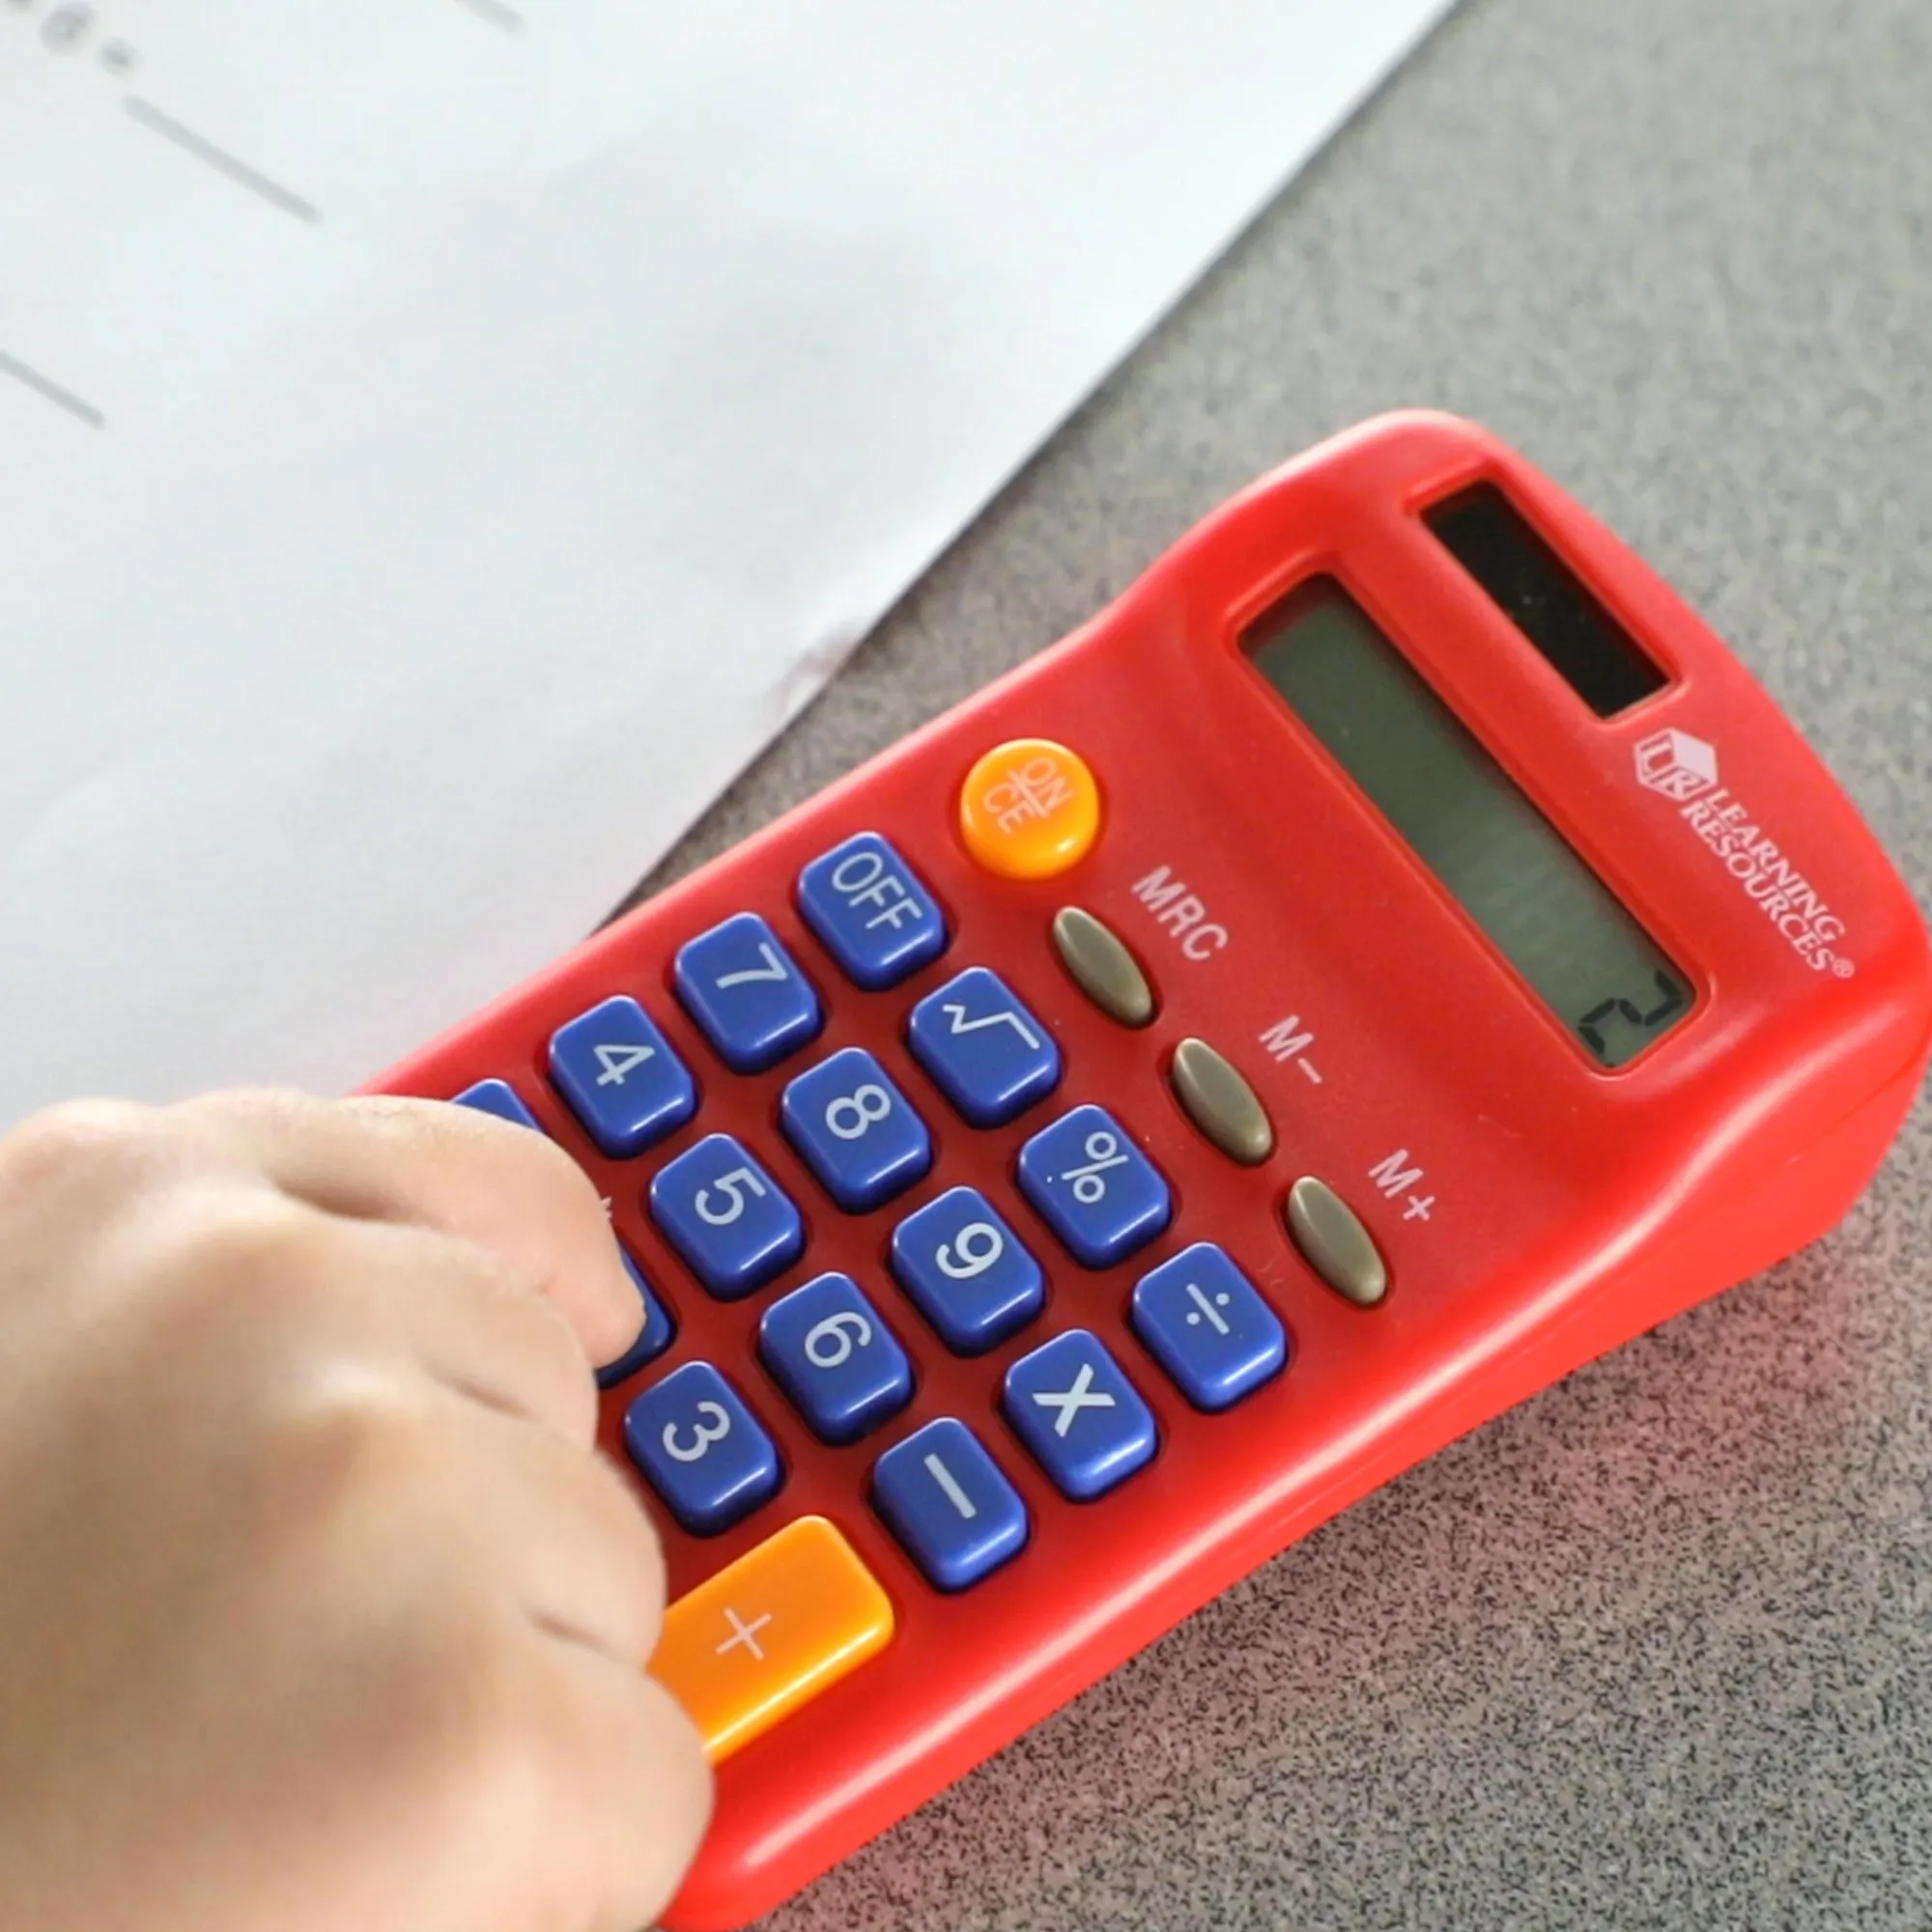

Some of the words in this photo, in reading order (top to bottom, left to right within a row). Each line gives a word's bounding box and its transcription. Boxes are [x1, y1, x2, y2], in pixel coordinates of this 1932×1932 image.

[981, 781, 1036, 836] CE
[1019, 755, 1075, 810] ON
[831, 851, 923, 930] OFF
[1704, 788, 1846, 943] LEARNING
[1130, 865, 1229, 962] MRC
[715, 942, 789, 990] 7
[1578, 969, 1683, 1054] 2
[592, 1042, 656, 1087] 4
[824, 1084, 892, 1140] 8
[694, 1166, 767, 1227] 5
[1061, 1130, 1130, 1205] %
[1367, 1149, 1436, 1222] M+
[934, 1221, 1004, 1280] 9
[804, 1311, 872, 1368] 6
[662, 1400, 731, 1463] 3
